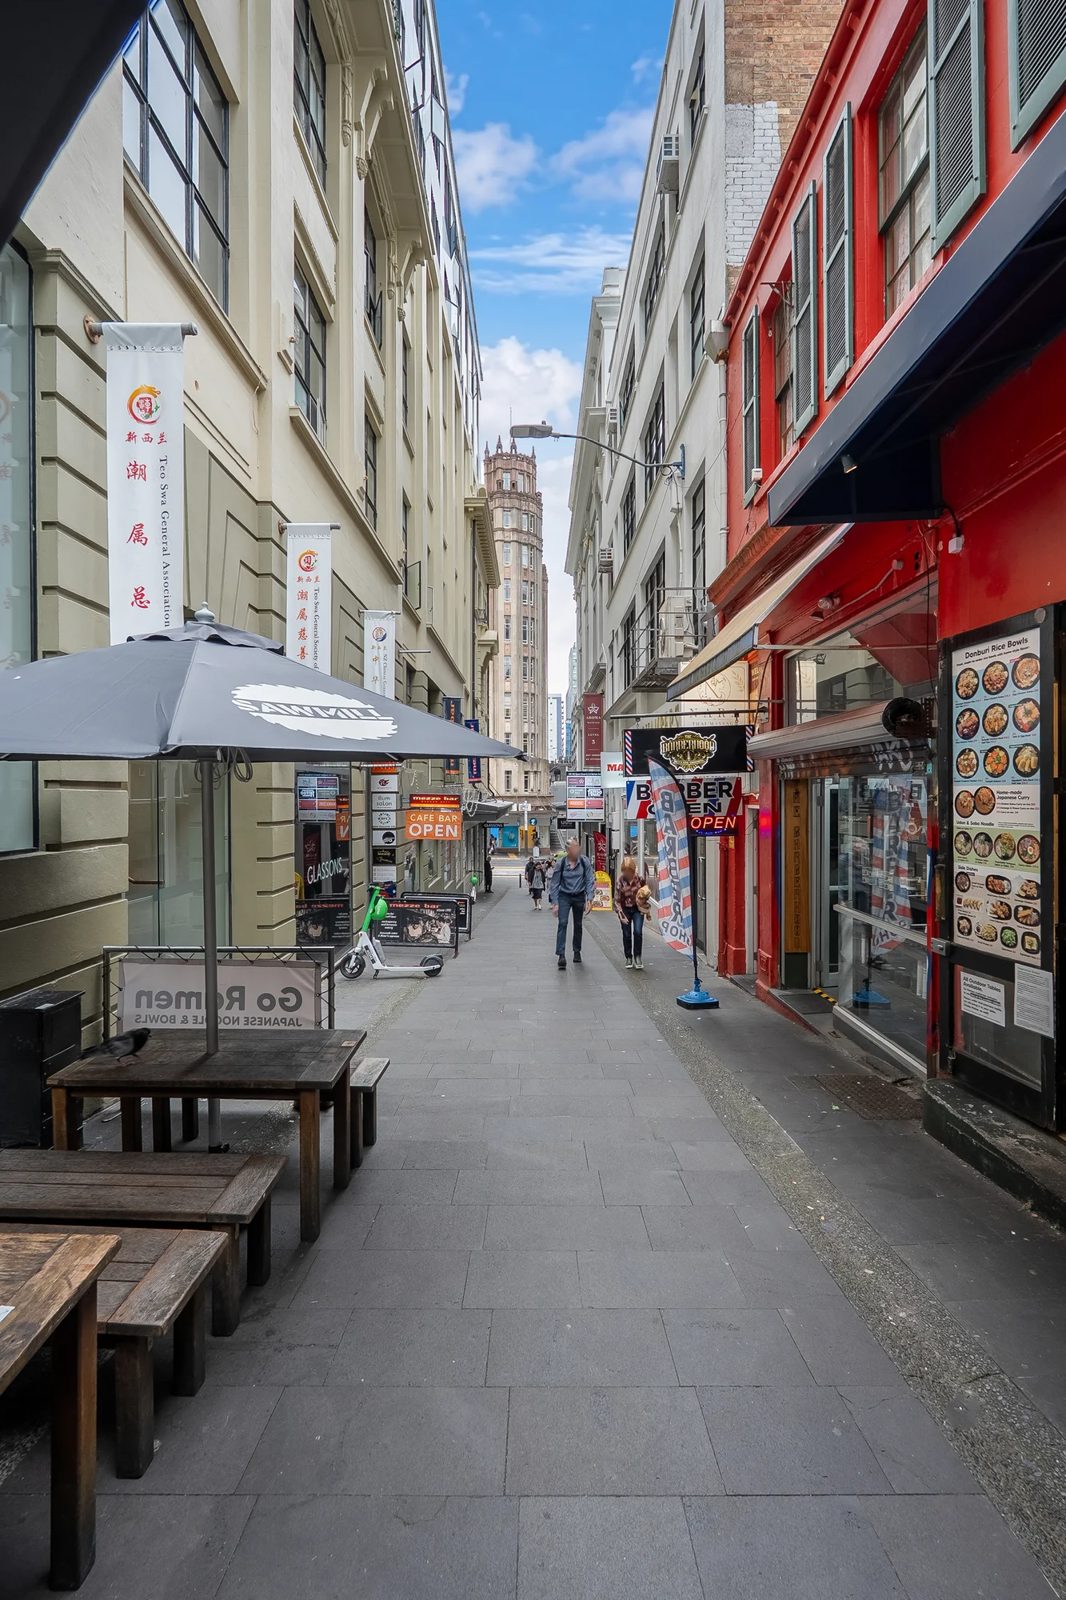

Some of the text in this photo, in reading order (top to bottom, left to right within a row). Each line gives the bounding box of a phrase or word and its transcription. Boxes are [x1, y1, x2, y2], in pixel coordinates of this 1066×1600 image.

[125, 431, 167, 445] 新西兰
[159, 455, 172, 627] Teo Swa General Association
[964, 646, 990, 659] Donburi
[991, 643, 1006, 652] Rice
[1007, 637, 1029, 648] Bowls
[233, 700, 394, 721] SAWMILL
[636, 781, 733, 801] BBER
[410, 814, 458, 822] CAFE BAR
[690, 816, 737, 829] OPEN
[409, 824, 458, 837] OPEN
[307, 856, 343, 885] GLASSONS
